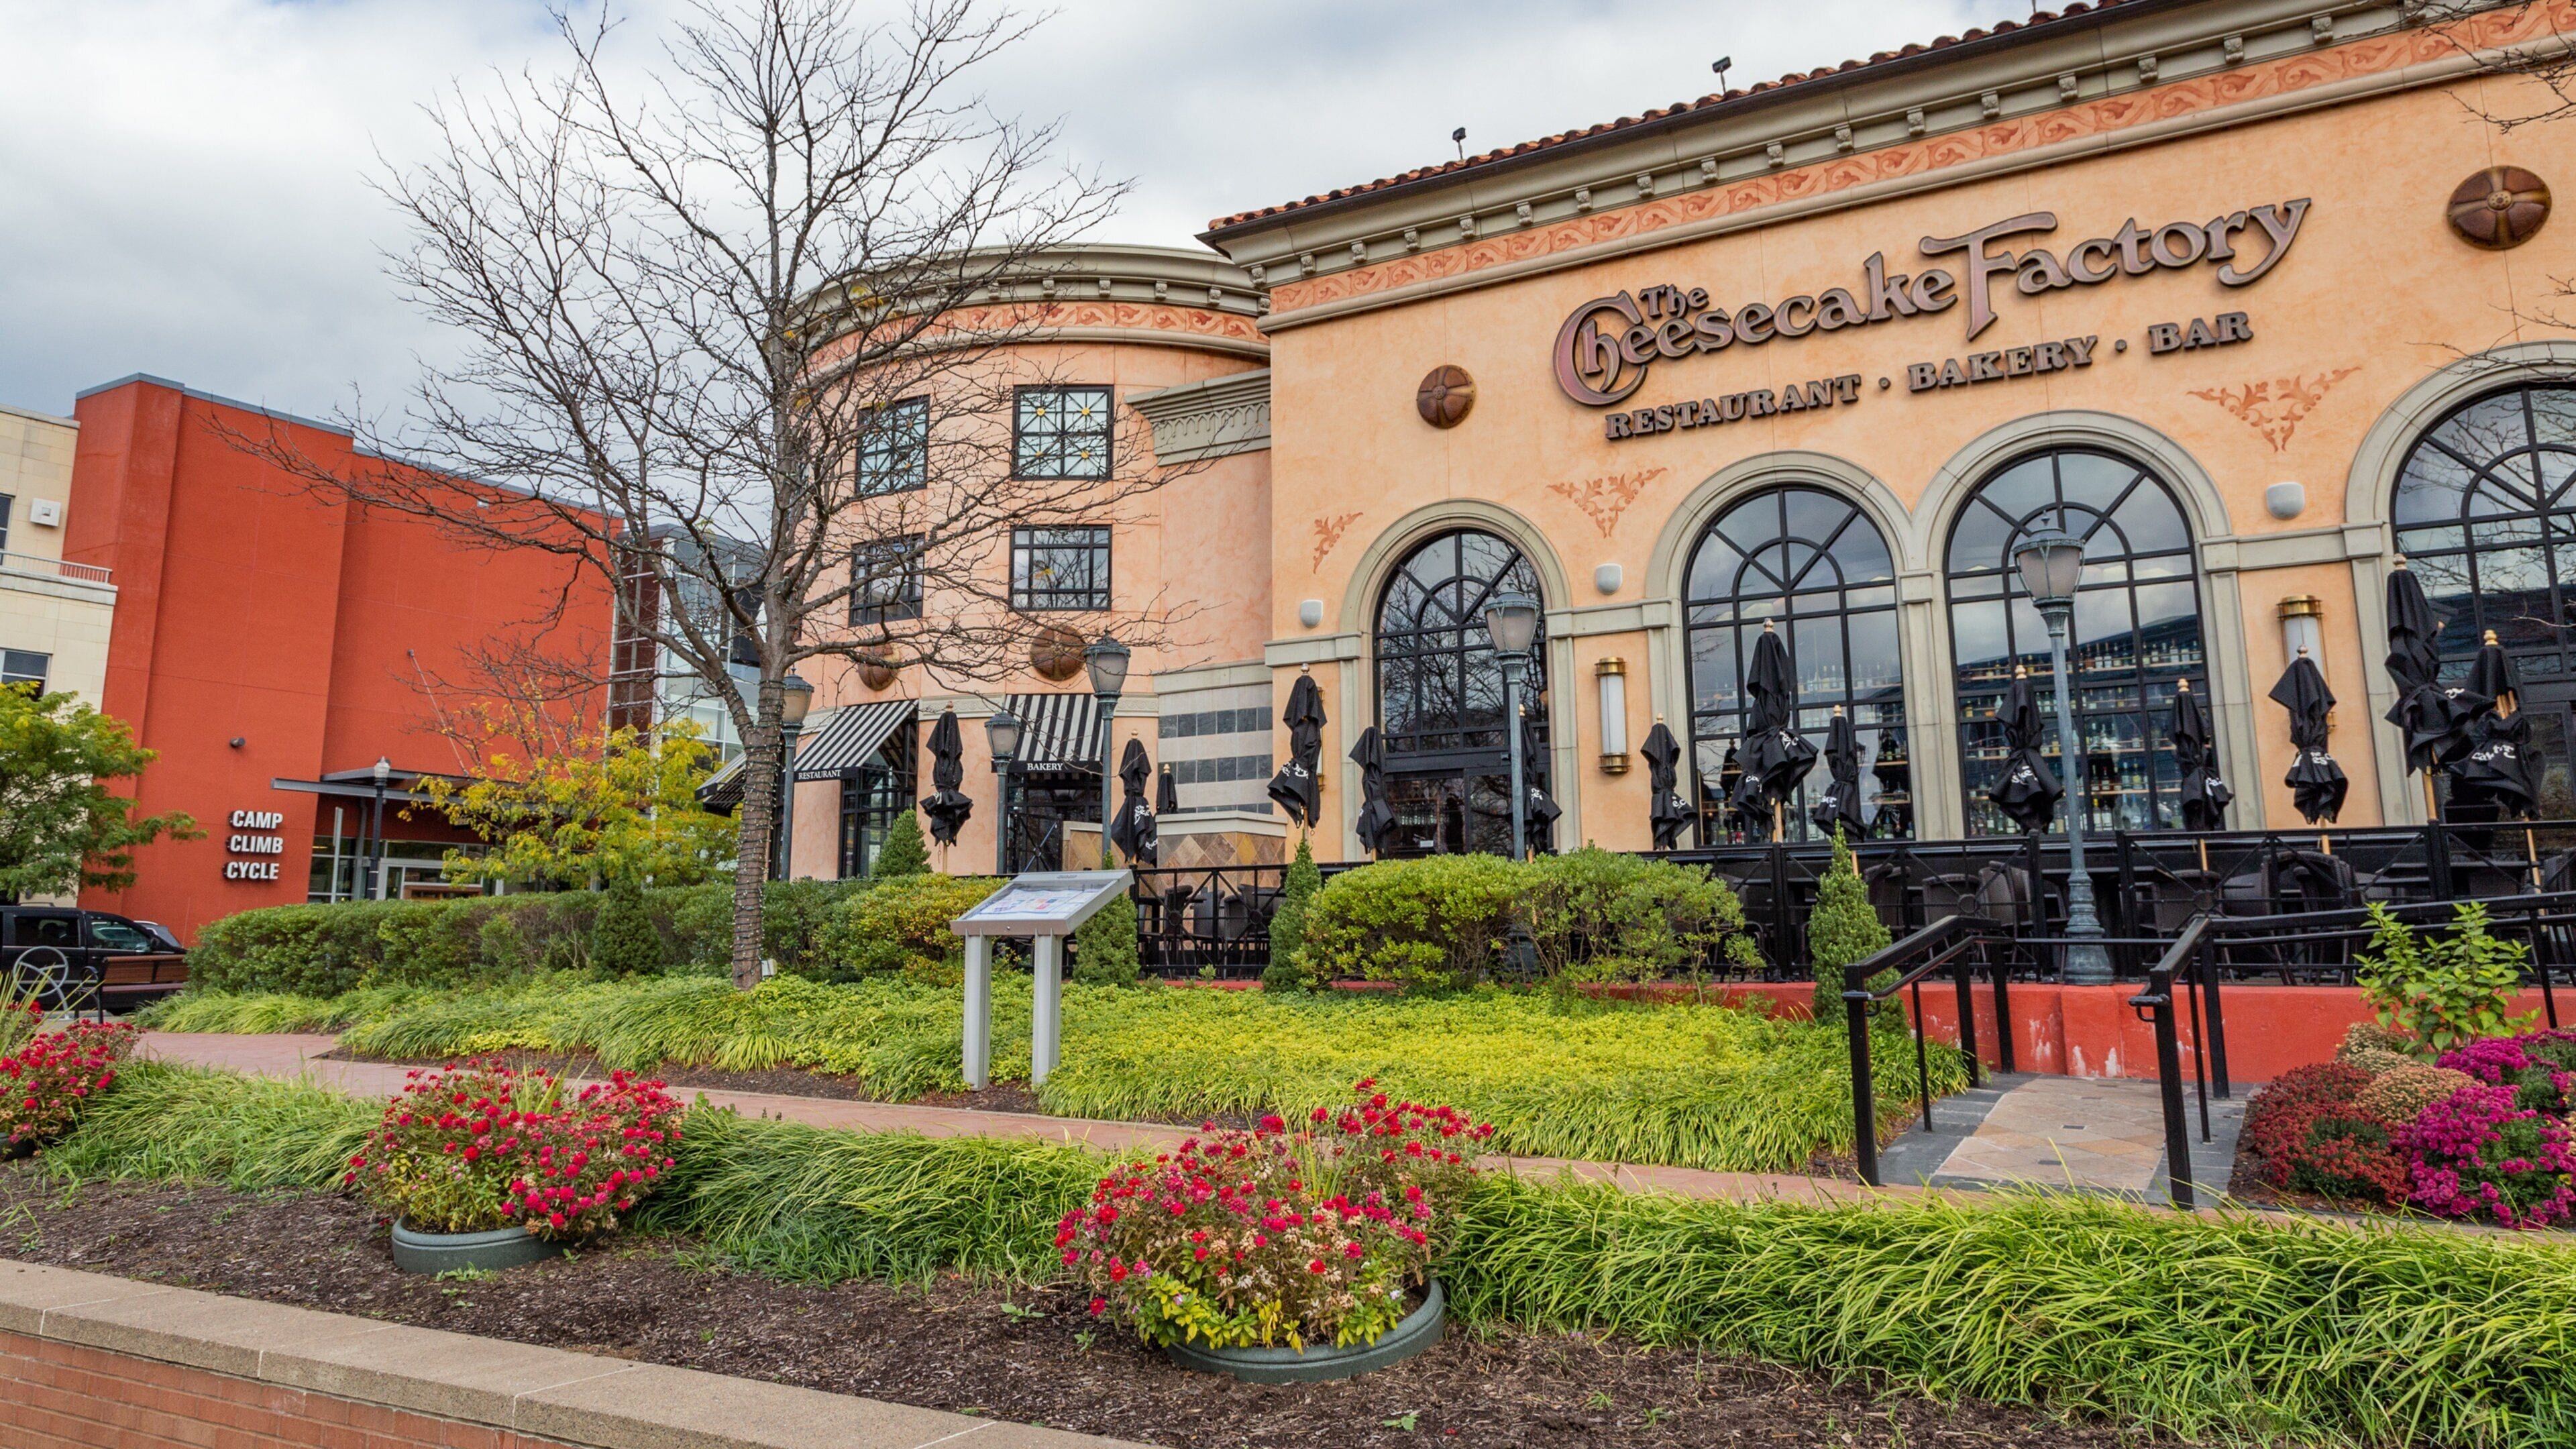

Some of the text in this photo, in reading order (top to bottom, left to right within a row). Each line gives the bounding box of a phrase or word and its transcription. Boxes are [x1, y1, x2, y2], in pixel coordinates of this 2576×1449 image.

[1552, 197, 2312, 406] The Cheesecake Factory
[1605, 311, 2254, 440] RESTAURANT BAKERY BAR
[798, 769, 842, 780] RESTAURANT
[1027, 762, 1063, 771] BAKERY
[232, 810, 283, 829] CAMP
[229, 835, 283, 853] CLIMB
[226, 861, 280, 880] CYCLE
